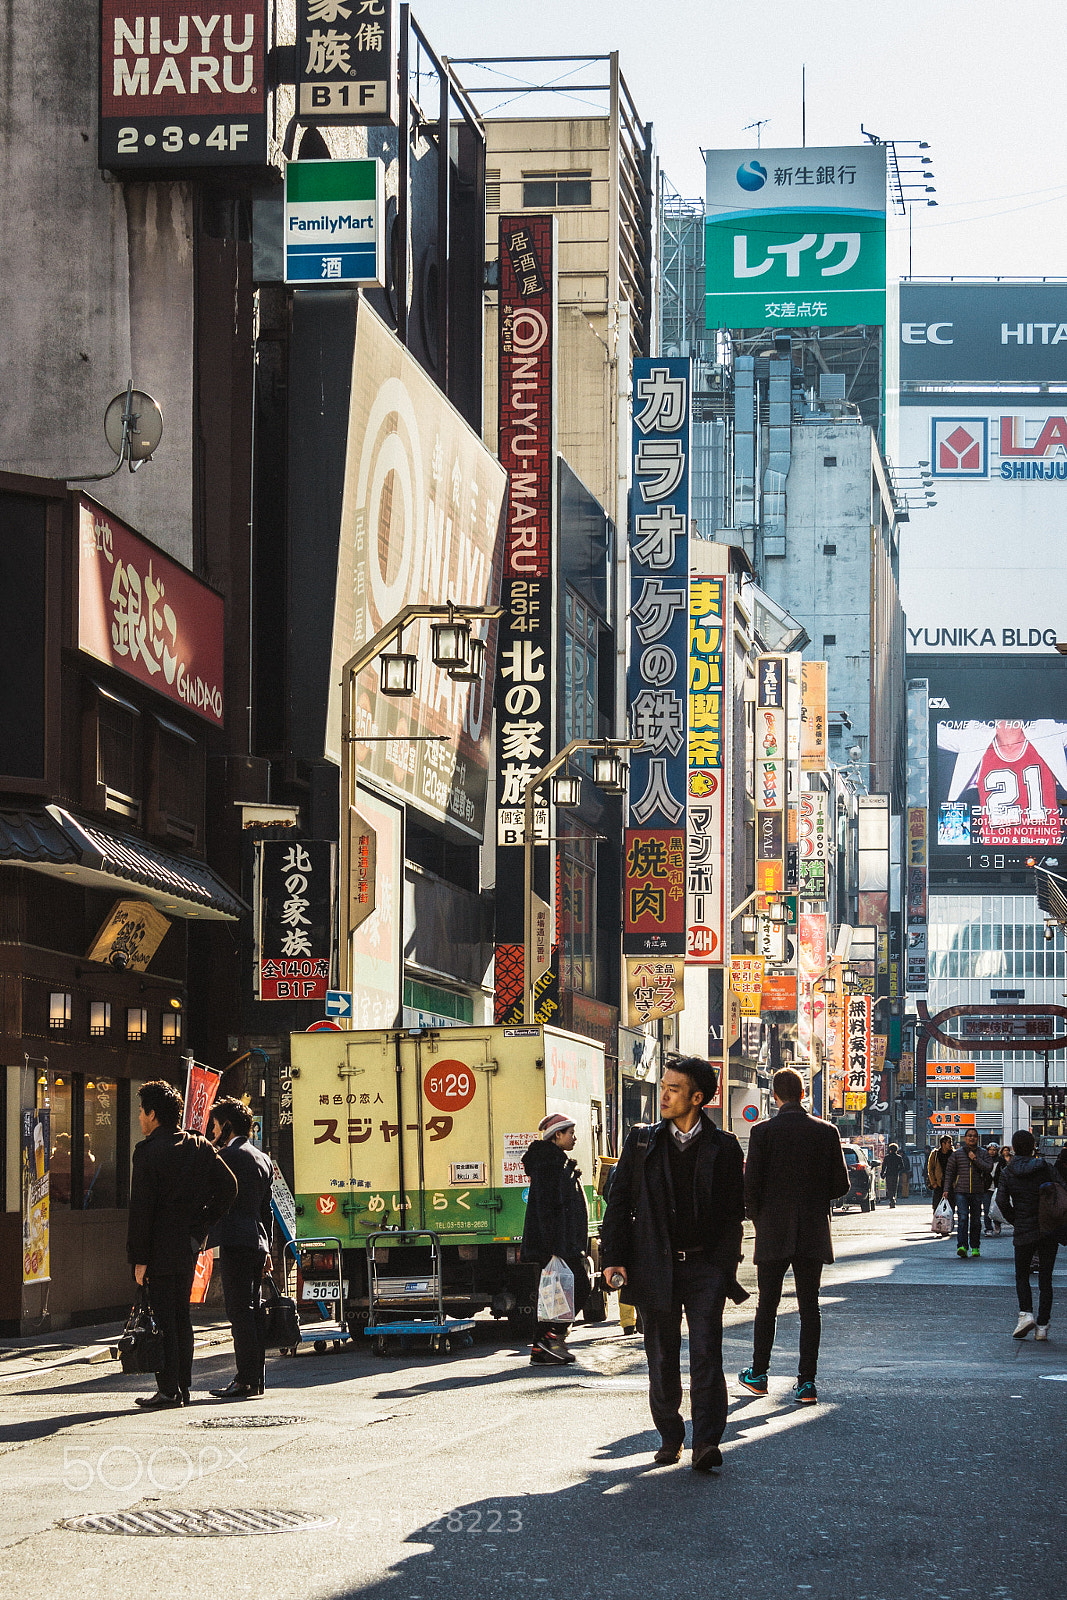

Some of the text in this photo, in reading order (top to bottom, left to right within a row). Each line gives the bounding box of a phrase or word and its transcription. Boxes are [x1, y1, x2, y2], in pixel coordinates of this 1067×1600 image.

[112, 14, 254, 55] NIJYU
[112, 55, 254, 97] MARU
[311, 84, 376, 108] B1F
[774, 164, 857, 187] 新生銀行
[289, 214, 375, 234] FamilyMart
[509, 231, 543, 295] 居酒屋
[733, 232, 861, 279] レイク
[320, 257, 343, 279] 酒
[764, 301, 828, 318] 交差点先
[511, 356, 540, 573] NIJYU-MARU
[511, 581, 540, 598] 2F
[632, 367, 688, 825] カラオケの鉄人
[510, 600, 540, 615] 3F
[510, 618, 540, 633] 4F
[908, 628, 1057, 647] YUNIKA BLDG
[500, 640, 546, 806] 北の家族
[983, 764, 1048, 829] 21
[500, 809, 547, 826] 個室備
[763, 817, 774, 853] ROYAL
[972, 836, 991, 845] LIVE
[992, 836, 1010, 845] DVD
[1011, 836, 1019, 845] &
[1020, 836, 1050, 846] Blu-ray
[998, 828, 1013, 836] OR
[669, 836, 684, 902] 黒毛和牛
[689, 806, 713, 923] マンボー
[627, 836, 669, 924] 焼肉
[805, 878, 825, 892] 4F
[280, 843, 313, 957] 北の家族
[687, 930, 713, 952] 24H
[262, 959, 329, 978] 全140席
[655, 964, 674, 974] 全品
[277, 981, 316, 998] B1F
[654, 975, 678, 1013] サラダ
[849, 1000, 867, 1087] 無料案内所
[430, 1073, 470, 1097] 5129
[318, 1092, 385, 1106] 褐色の恋人
[313, 1115, 454, 1146] スジャータ
